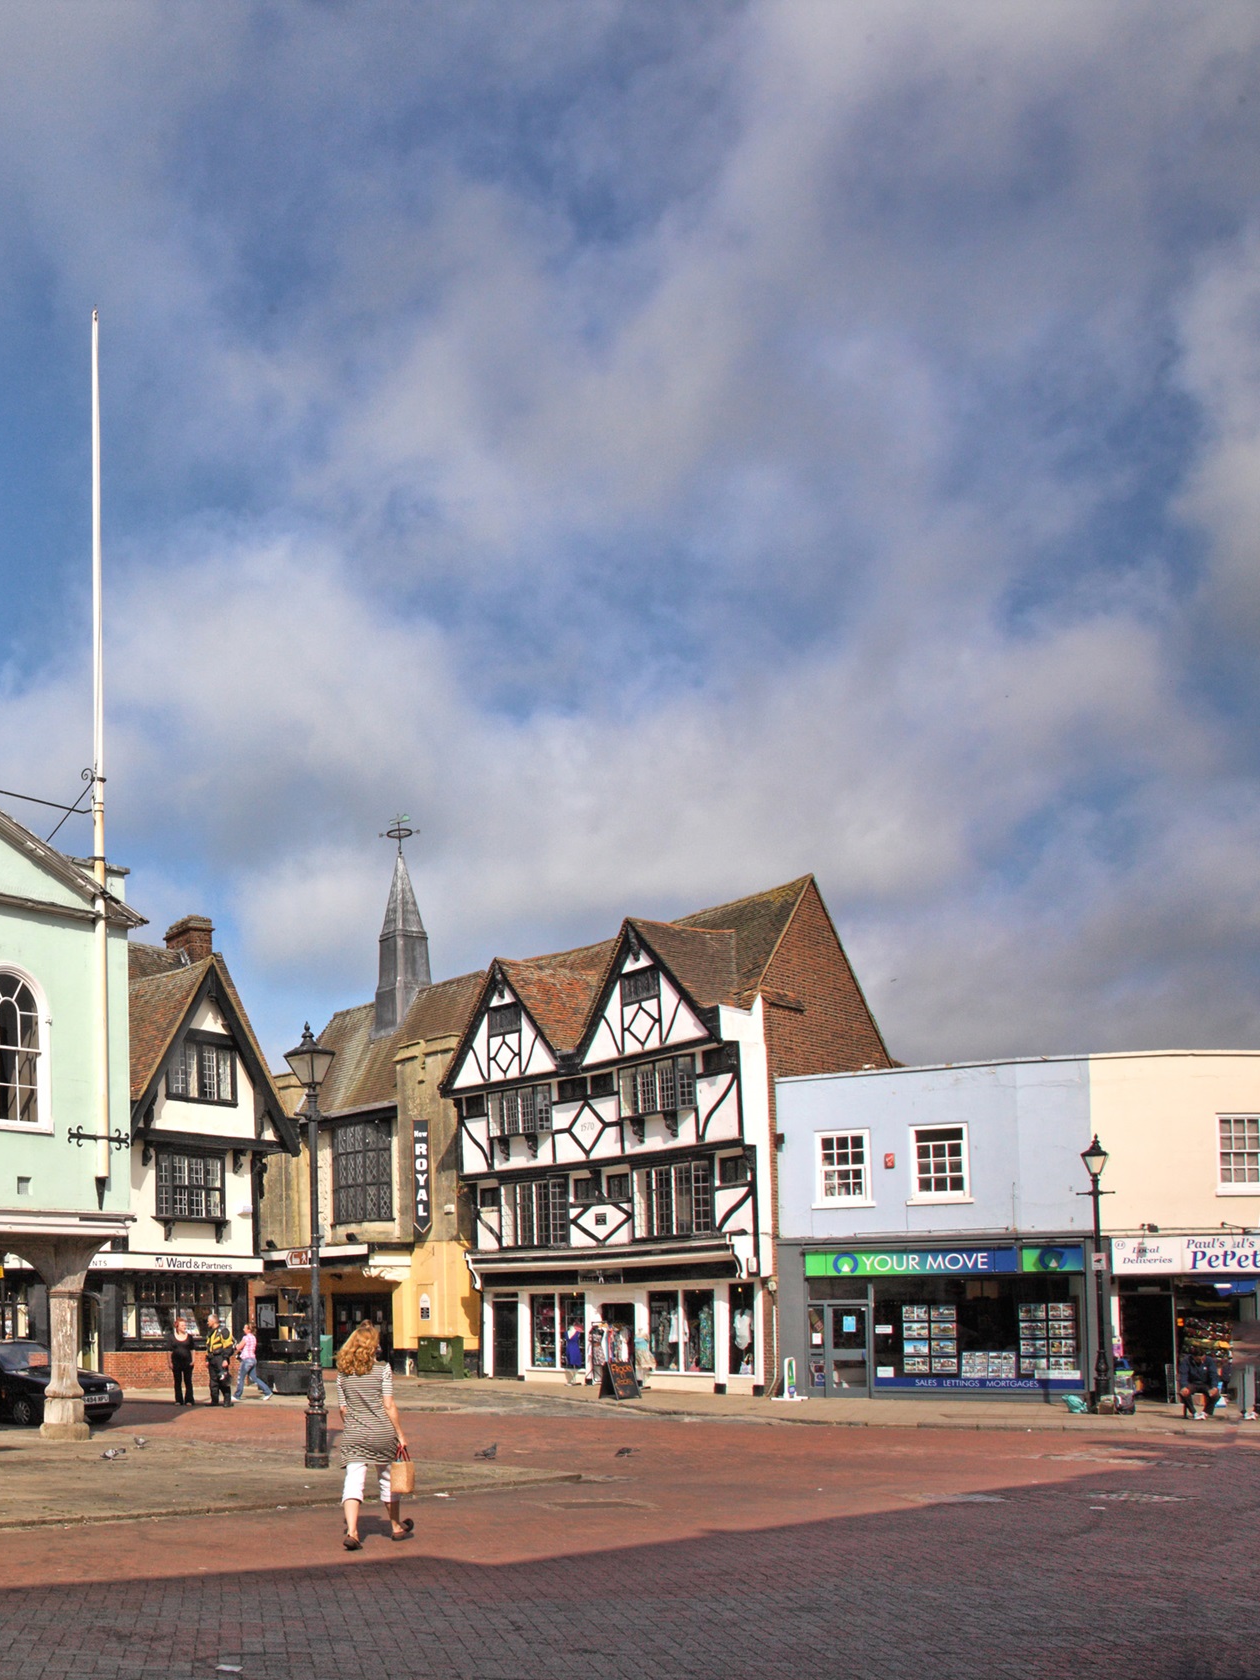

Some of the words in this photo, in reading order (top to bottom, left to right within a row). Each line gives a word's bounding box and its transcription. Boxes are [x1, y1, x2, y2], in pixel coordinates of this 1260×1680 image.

[414, 1143, 428, 1216] ROYAL
[1186, 1238, 1225, 1249] Paul's
[1132, 1246, 1159, 1254] Local
[166, 1257, 192, 1269] Ward
[201, 1261, 233, 1270] Partners
[861, 1254, 920, 1271] YOUR
[926, 1253, 988, 1270] MOVE
[1122, 1256, 1173, 1265] Deliveries
[915, 1379, 937, 1387] SALES
[943, 1379, 980, 1388] LETTINGS
[986, 1380, 1039, 1388] MORTGAGES
